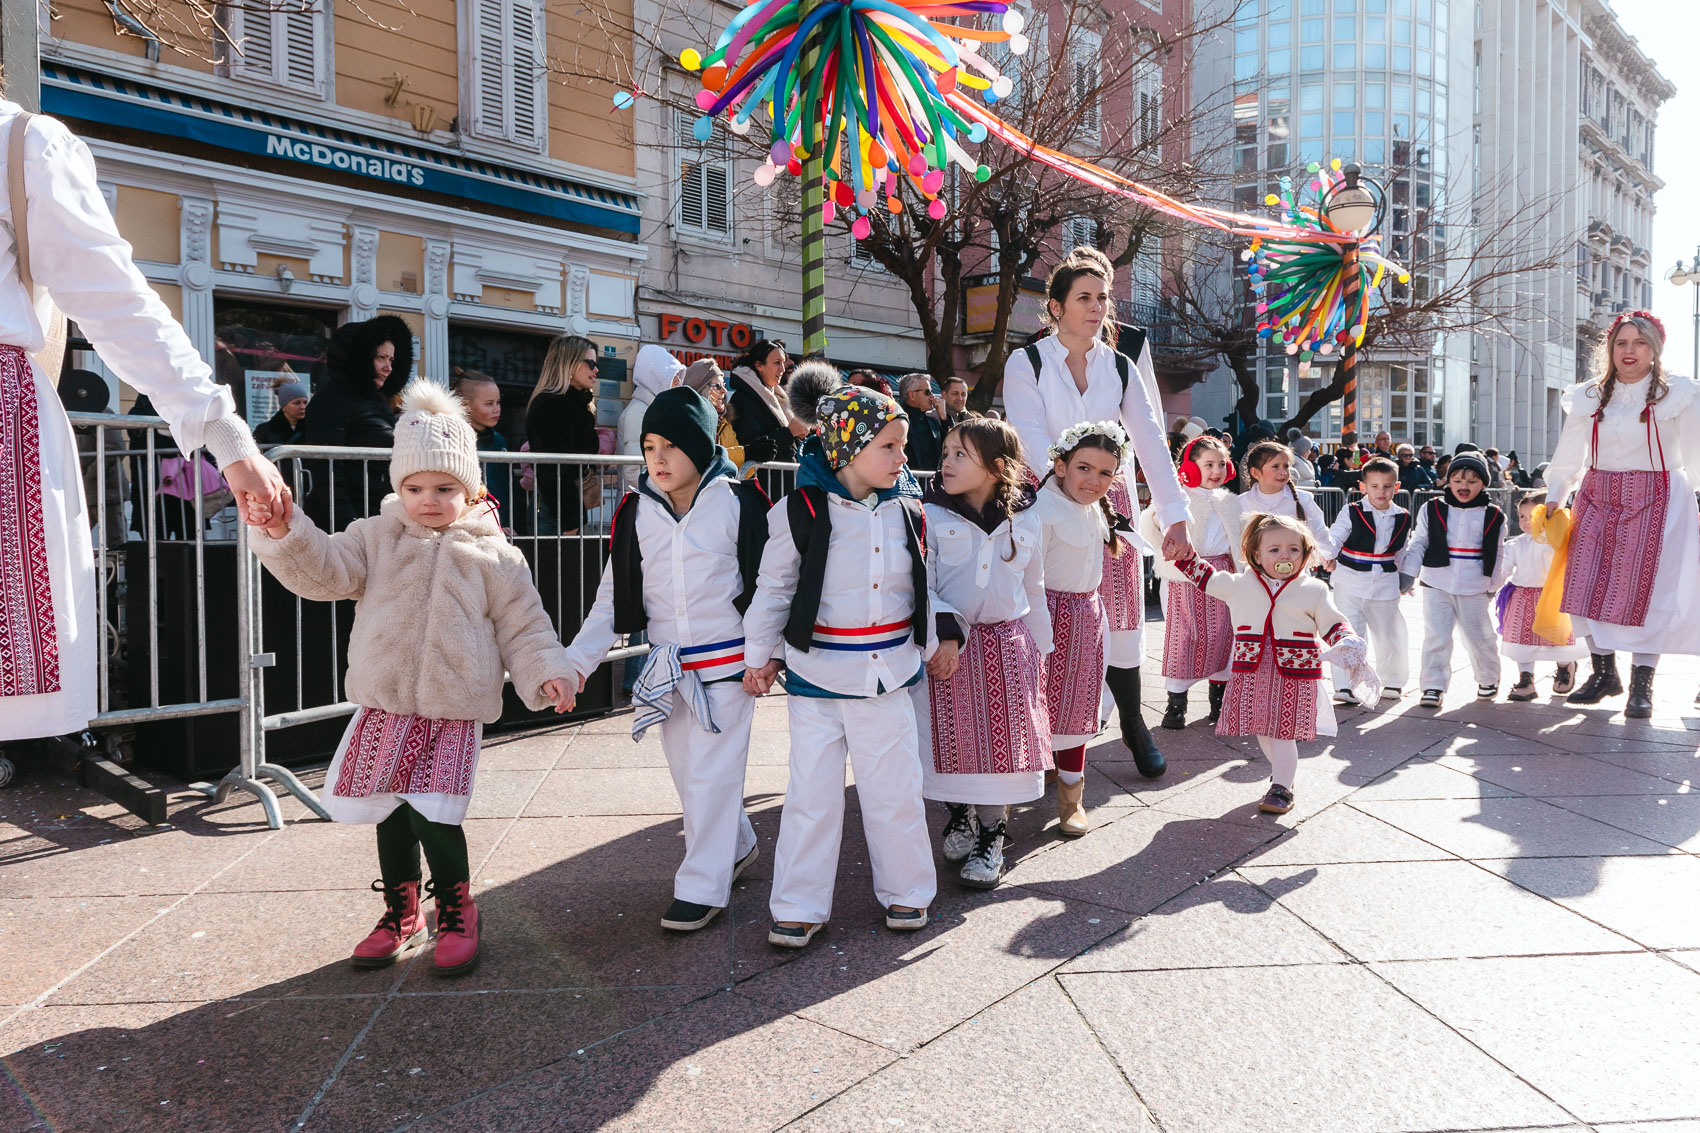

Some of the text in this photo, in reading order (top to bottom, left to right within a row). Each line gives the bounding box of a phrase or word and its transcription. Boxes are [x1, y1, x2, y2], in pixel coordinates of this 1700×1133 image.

[266, 134, 425, 186] McDonald's
[660, 312, 751, 349] FOTO
[669, 349, 738, 372] ADRNK
